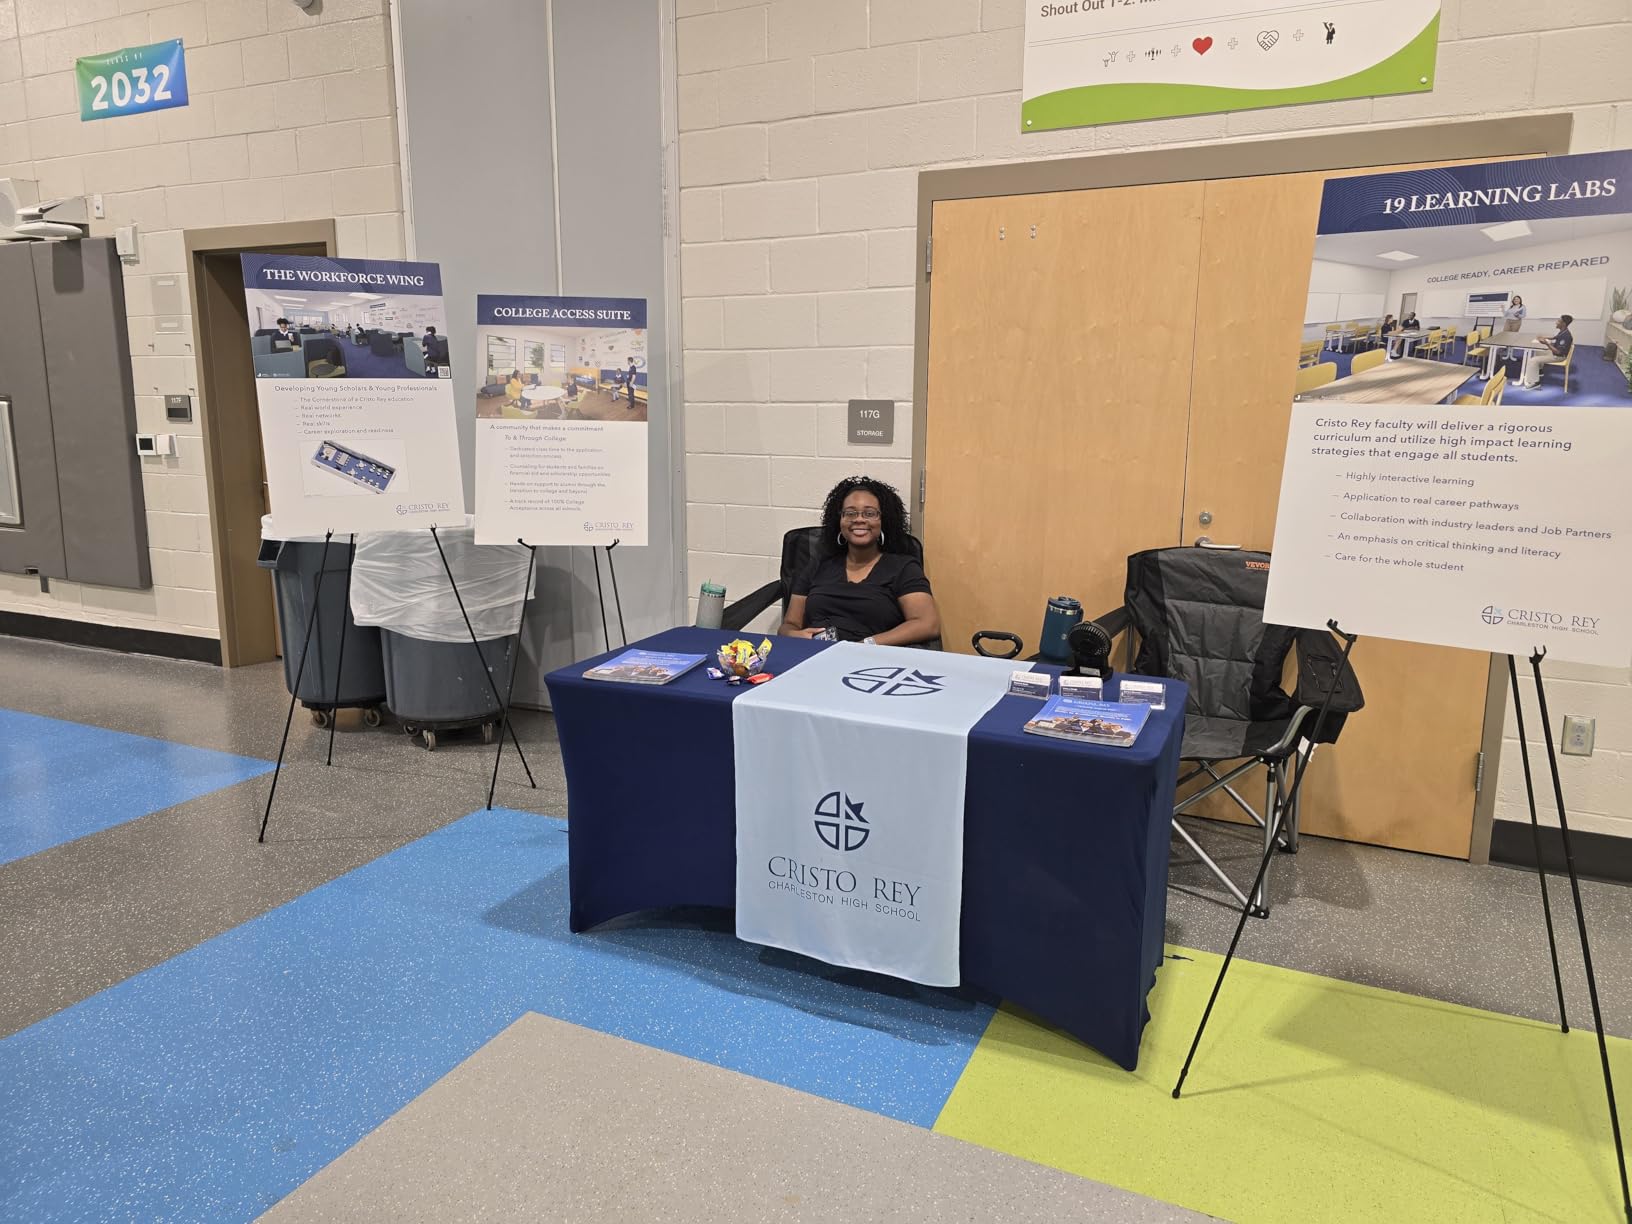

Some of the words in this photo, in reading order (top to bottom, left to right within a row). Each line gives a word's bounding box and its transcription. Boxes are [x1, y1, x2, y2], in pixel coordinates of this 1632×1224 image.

[1041, 3, 1078, 17] Shout
[1082, 0, 1104, 11] Out
[91, 64, 172, 111] 2032
[1382, 196, 1406, 214] 19
[1408, 184, 1543, 213] LEARNING
[1547, 178, 1617, 202] LABS
[263, 268, 295, 281] THE
[296, 270, 385, 285] WORKFORCE
[386, 275, 425, 287] WING
[1427, 274, 1459, 284] COLLEGE
[1460, 270, 1490, 280] READY,
[1493, 264, 1535, 277] CAREER
[1537, 255, 1610, 272] PREPARED
[494, 307, 550, 319] COLLEGE
[551, 308, 595, 319] ACCESS
[596, 310, 631, 320] SUITE
[860, 410, 880, 418] 117G
[1316, 418, 1348, 427] Cristo
[1351, 419, 1372, 430] Rey
[1374, 419, 1414, 432] faculty
[1416, 420, 1437, 430] will
[1441, 421, 1484, 431] deliver
[1498, 422, 1552, 434] rigorous
[1314, 433, 1372, 442] curriculum
[1374, 434, 1396, 443] and
[1400, 435, 1436, 444] utilize
[1440, 436, 1466, 448] high
[1470, 437, 1514, 448] impact
[1518, 438, 1572, 452] learning
[1312, 447, 1365, 458] strategies
[1369, 448, 1391, 457] that
[1394, 450, 1440, 461] engage
[1443, 451, 1458, 460] all
[1460, 452, 1518, 462] students.
[1346, 472, 1376, 482] Highly
[1379, 474, 1430, 484] interactive
[1433, 476, 1474, 488] learning
[1344, 492, 1398, 502] Application
[1434, 499, 1466, 507] career
[1469, 500, 1520, 512] pathways
[1340, 512, 1404, 524] Collaboration
[1408, 517, 1428, 526] with
[1432, 519, 1472, 530] industry
[1476, 521, 1514, 532] leaders
[1518, 526, 1538, 534] and
[1541, 526, 1562, 536] Job
[1566, 528, 1612, 539] Partners
[1354, 534, 1398, 544] emphasis
[1416, 538, 1449, 548] critical
[1452, 542, 1494, 554] thinking
[1498, 546, 1518, 554] and
[1522, 547, 1560, 560] literacy
[1335, 552, 1356, 561] Care
[1360, 554, 1372, 563] for
[1376, 556, 1390, 564] the
[1394, 558, 1422, 568] whole
[1426, 561, 1464, 572] student
[1507, 620, 1549, 629] CHARLESTON
[1571, 627, 1599, 635] SCHOOL
[1508, 608, 1562, 624] CRISTO
[1571, 615, 1600, 629] REY
[768, 855, 857, 893] CRISTO
[873, 877, 922, 907] REY
[768, 880, 834, 905] CHARLESTON
[841, 896, 868, 910] HIGH
[875, 903, 921, 922] SCHOOL
